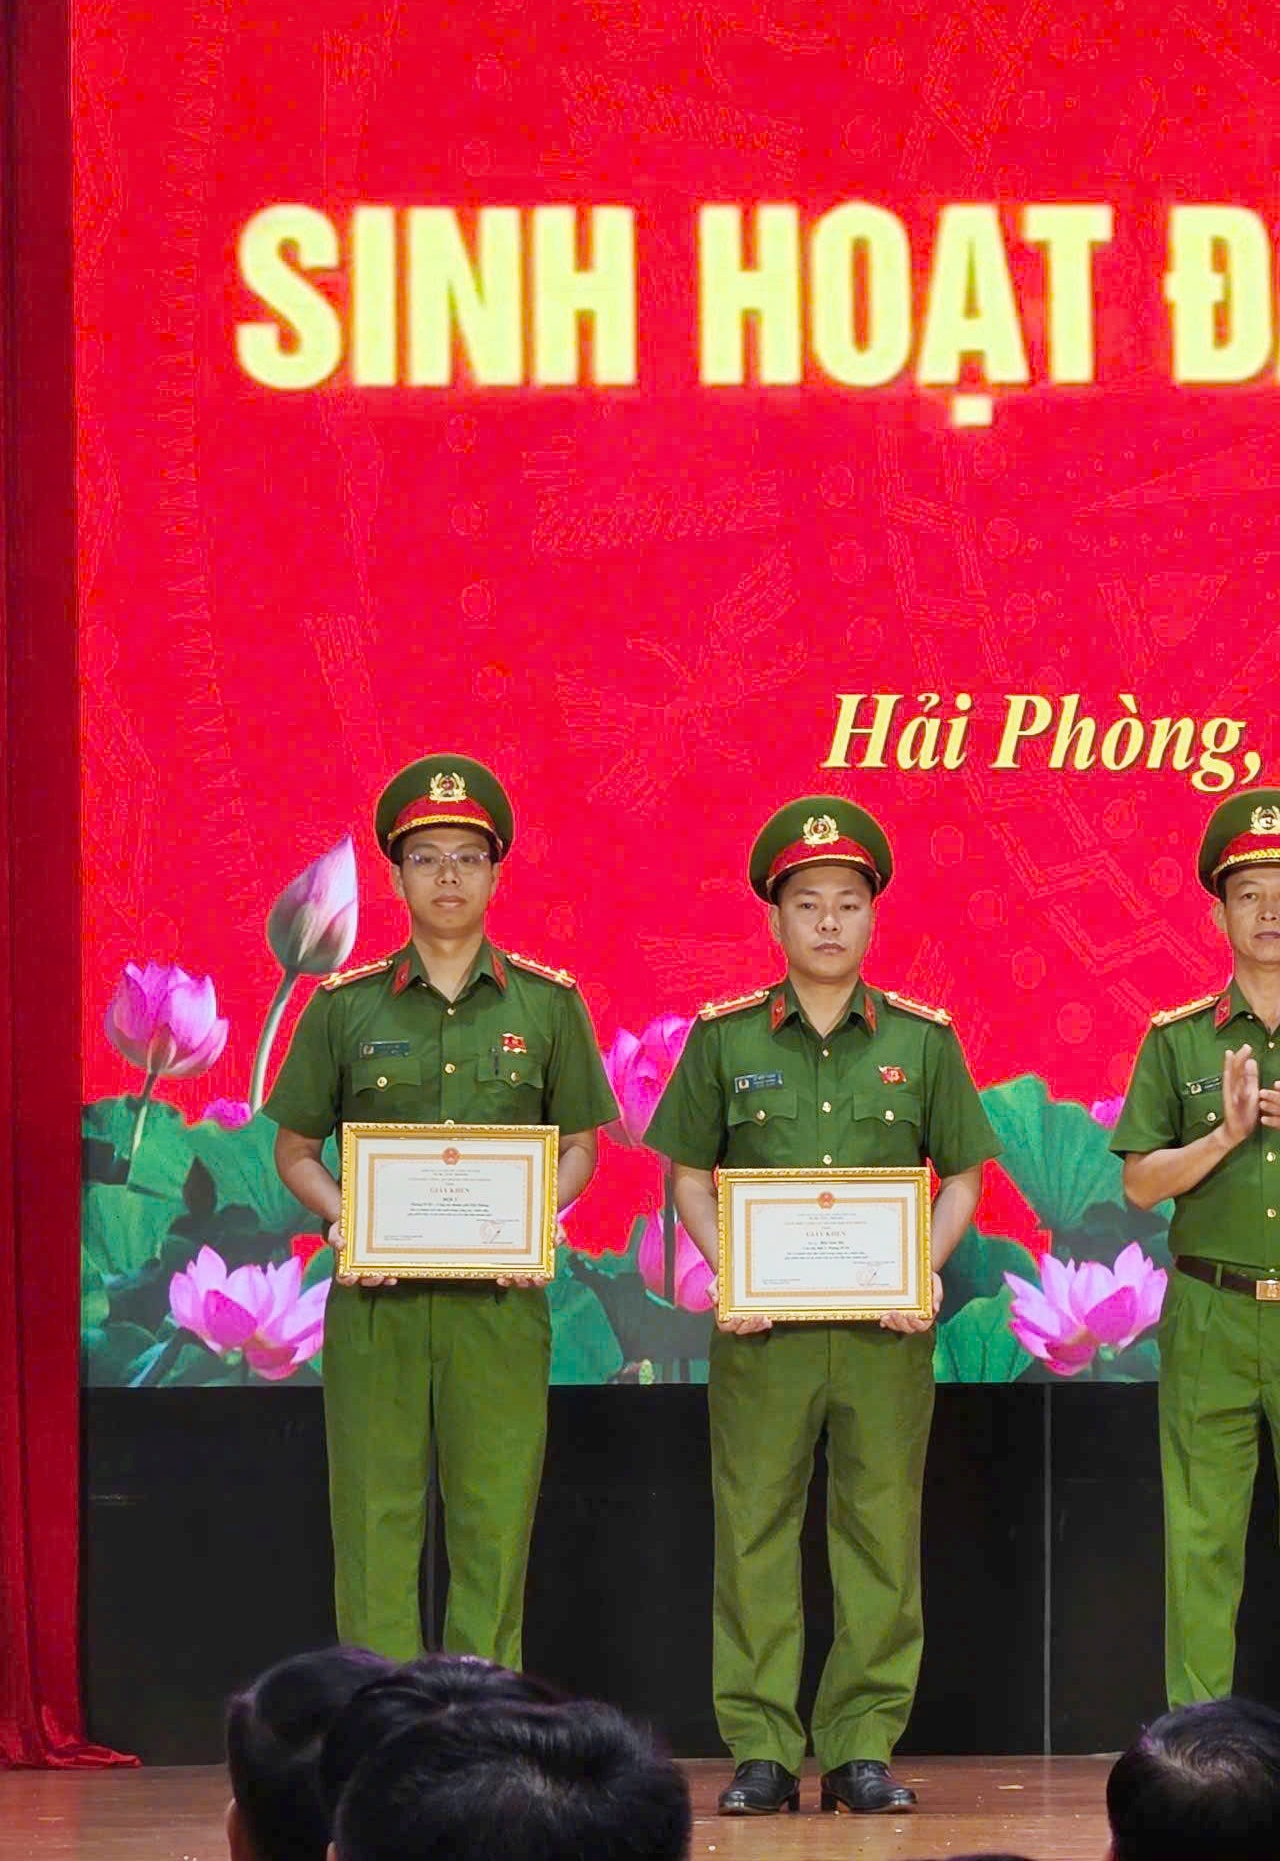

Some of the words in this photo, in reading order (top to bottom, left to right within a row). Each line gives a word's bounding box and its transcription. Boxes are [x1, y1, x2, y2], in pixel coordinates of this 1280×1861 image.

[238, 205, 635, 389] SINH
[699, 203, 1112, 426] HOẠT
[822, 693, 971, 770] Hải
[991, 693, 1263, 794] Phòng,
